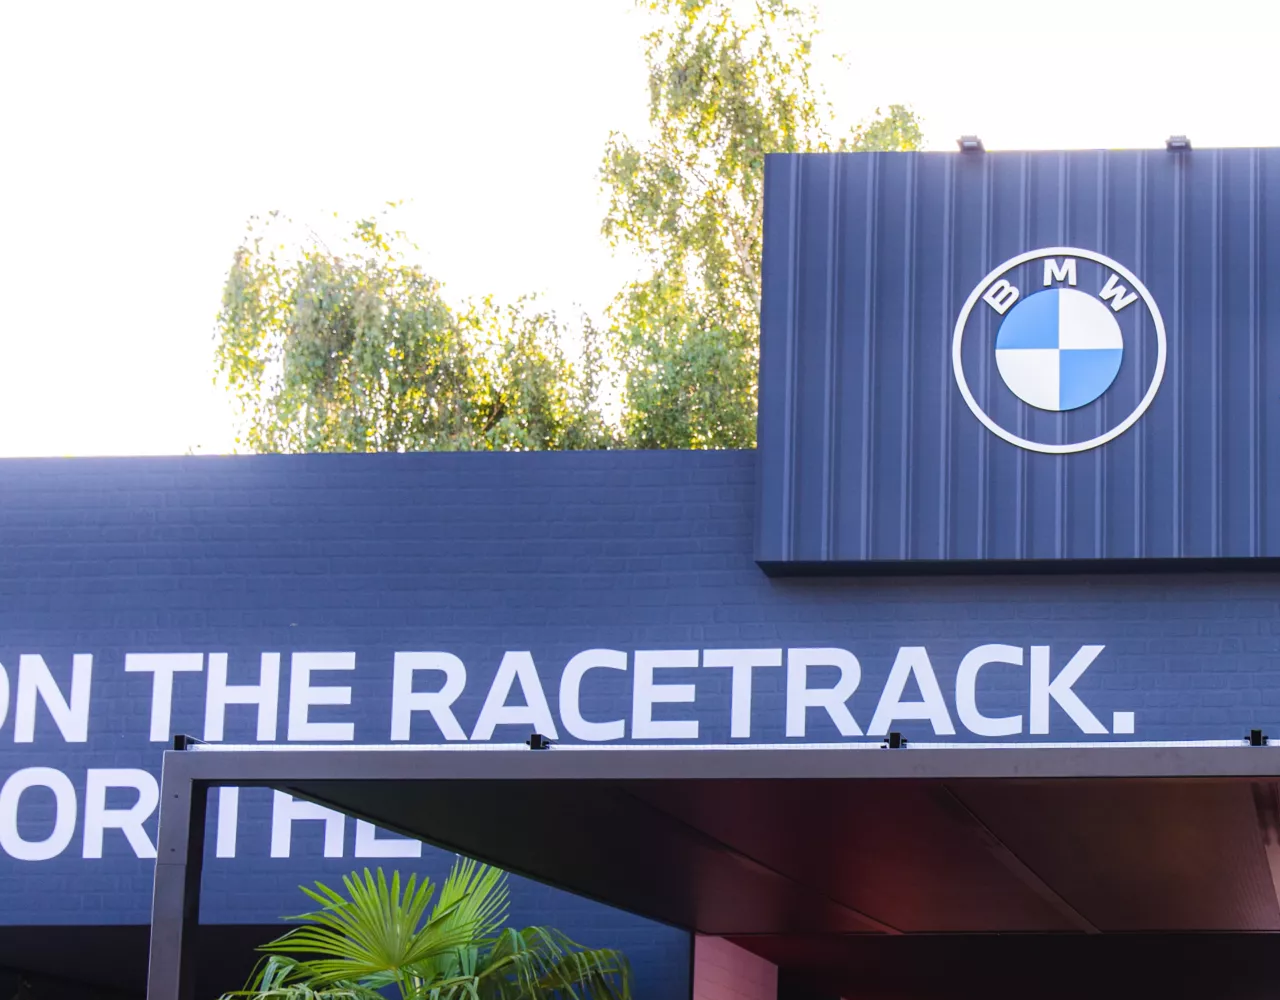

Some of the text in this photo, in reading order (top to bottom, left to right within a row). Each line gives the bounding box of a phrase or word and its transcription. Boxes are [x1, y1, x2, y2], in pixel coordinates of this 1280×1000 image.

[983, 258, 1137, 314] BMW
[0, 644, 1135, 743] N THE RACETRACK.
